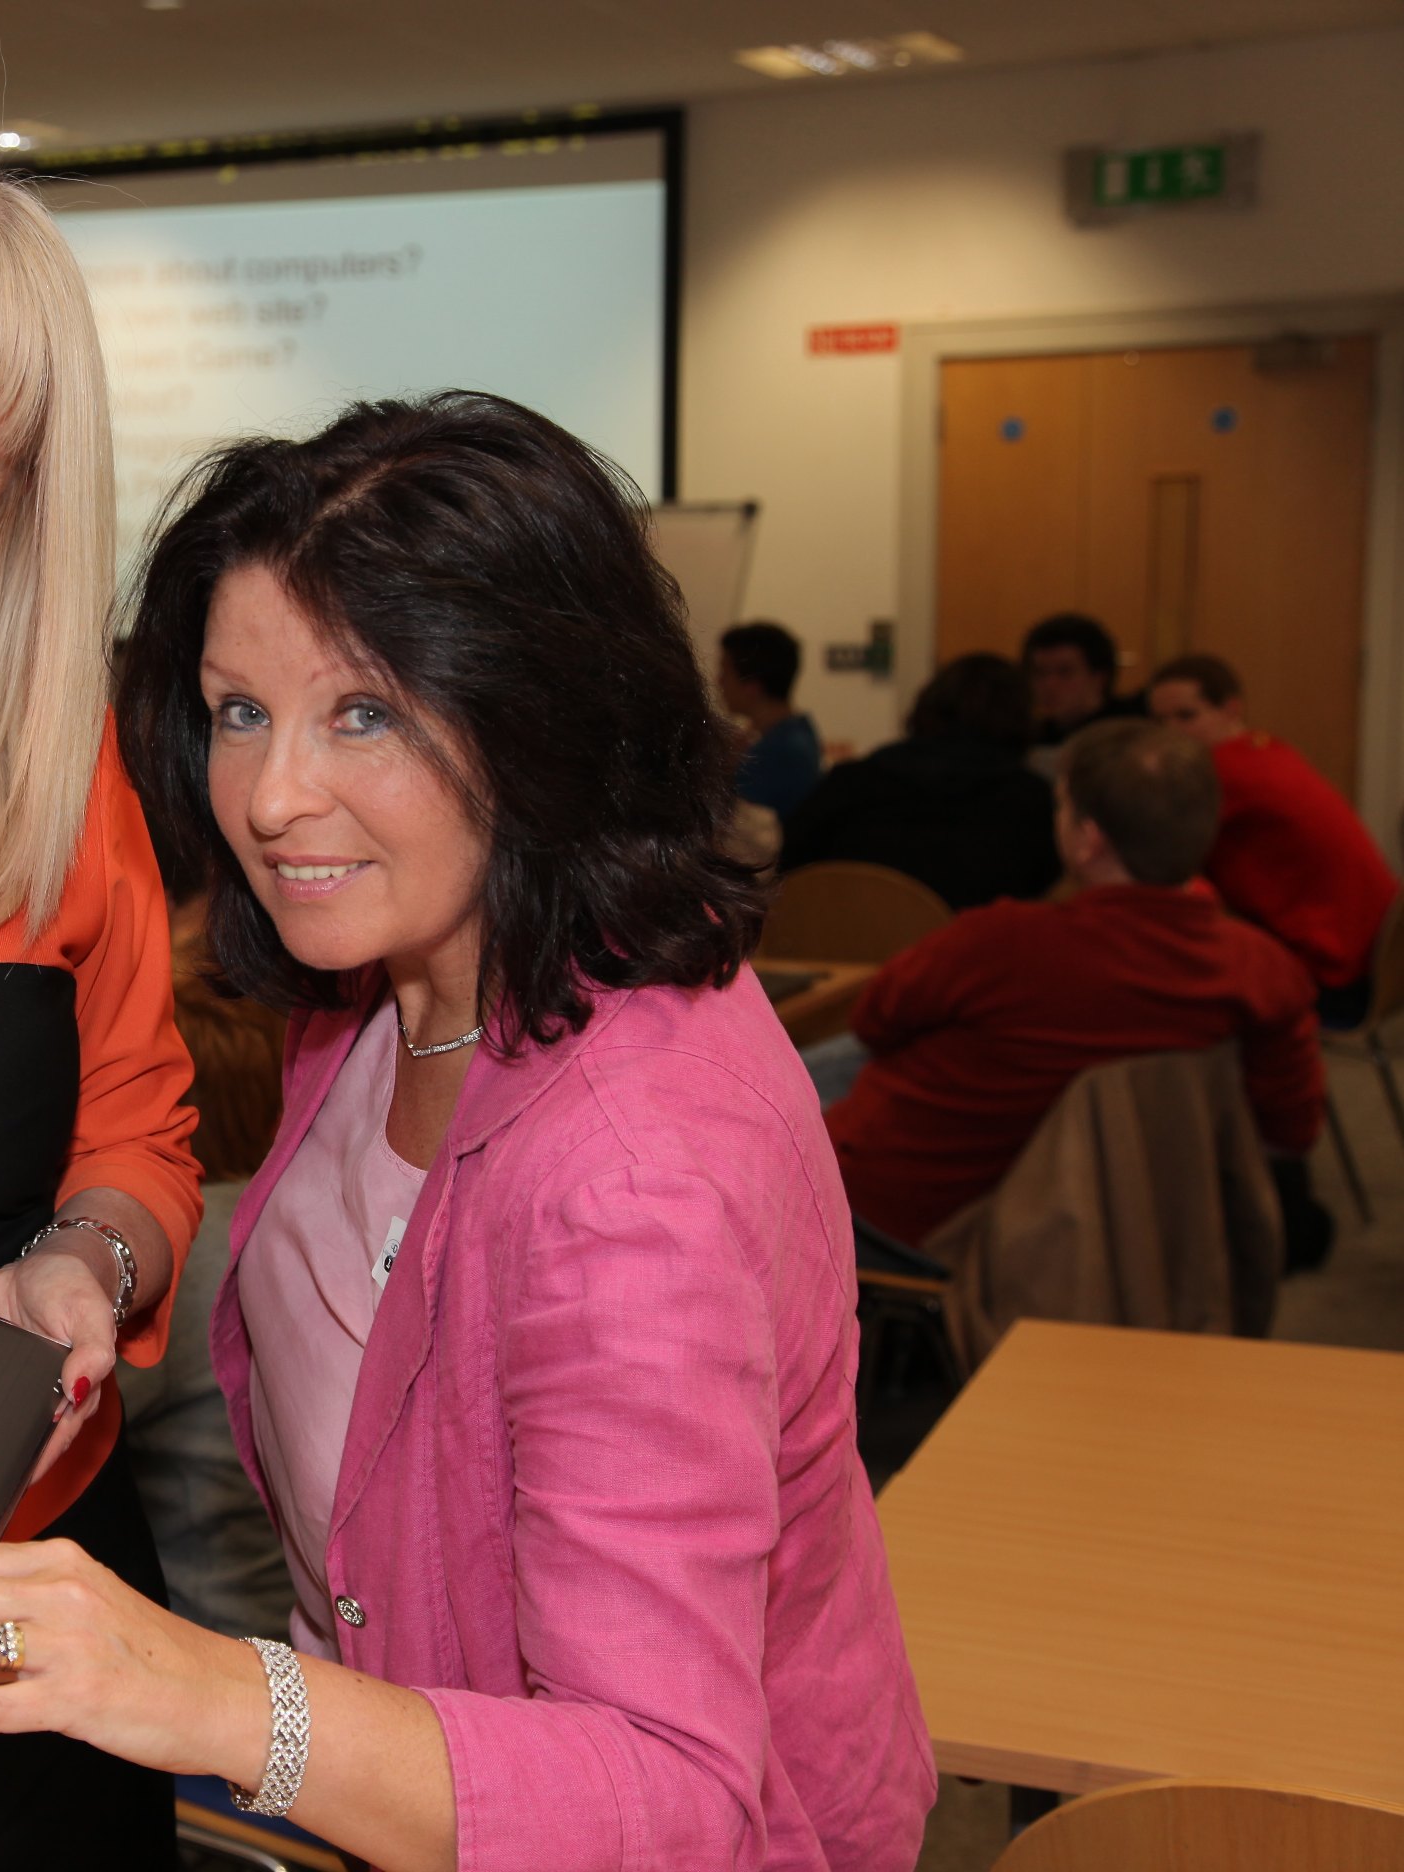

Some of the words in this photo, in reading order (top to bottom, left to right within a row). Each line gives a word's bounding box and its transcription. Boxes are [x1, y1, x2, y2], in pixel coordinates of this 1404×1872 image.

[153, 257, 238, 284] about
[244, 242, 424, 285] computers?
[254, 292, 329, 325] site?
